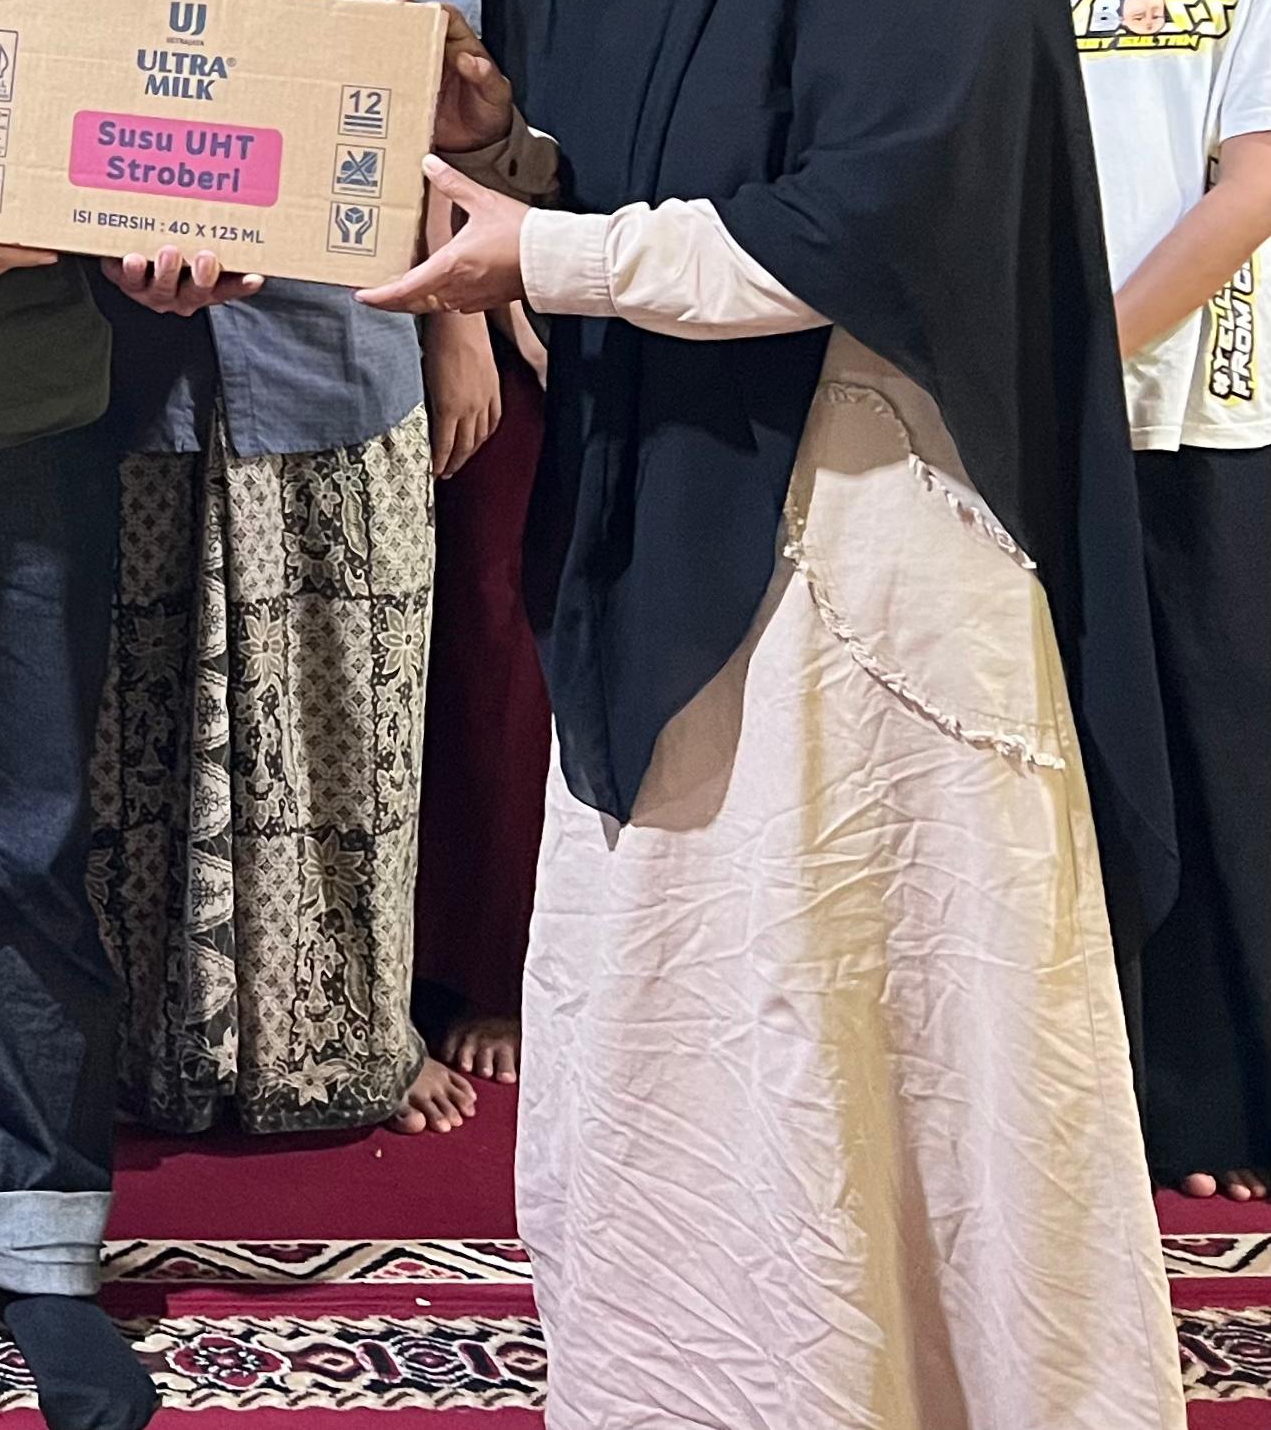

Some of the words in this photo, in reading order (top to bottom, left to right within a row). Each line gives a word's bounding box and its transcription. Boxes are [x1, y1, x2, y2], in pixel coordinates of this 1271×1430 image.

[137, 49, 227, 78] ULTRA
[145, 74, 215, 100] MILK
[349, 90, 382, 115] 12
[97, 121, 173, 152] Susu
[186, 130, 254, 160] UHT
[106, 155, 240, 193] Stroberi
[73, 209, 91, 224] ISI
[98, 212, 155, 231] BERSIH
[169, 221, 190, 235] 40
[195, 224, 206, 237] X
[211, 226, 238, 241] 125
[242, 230, 264, 244] ML
[1230, 305, 1253, 400] FROM
